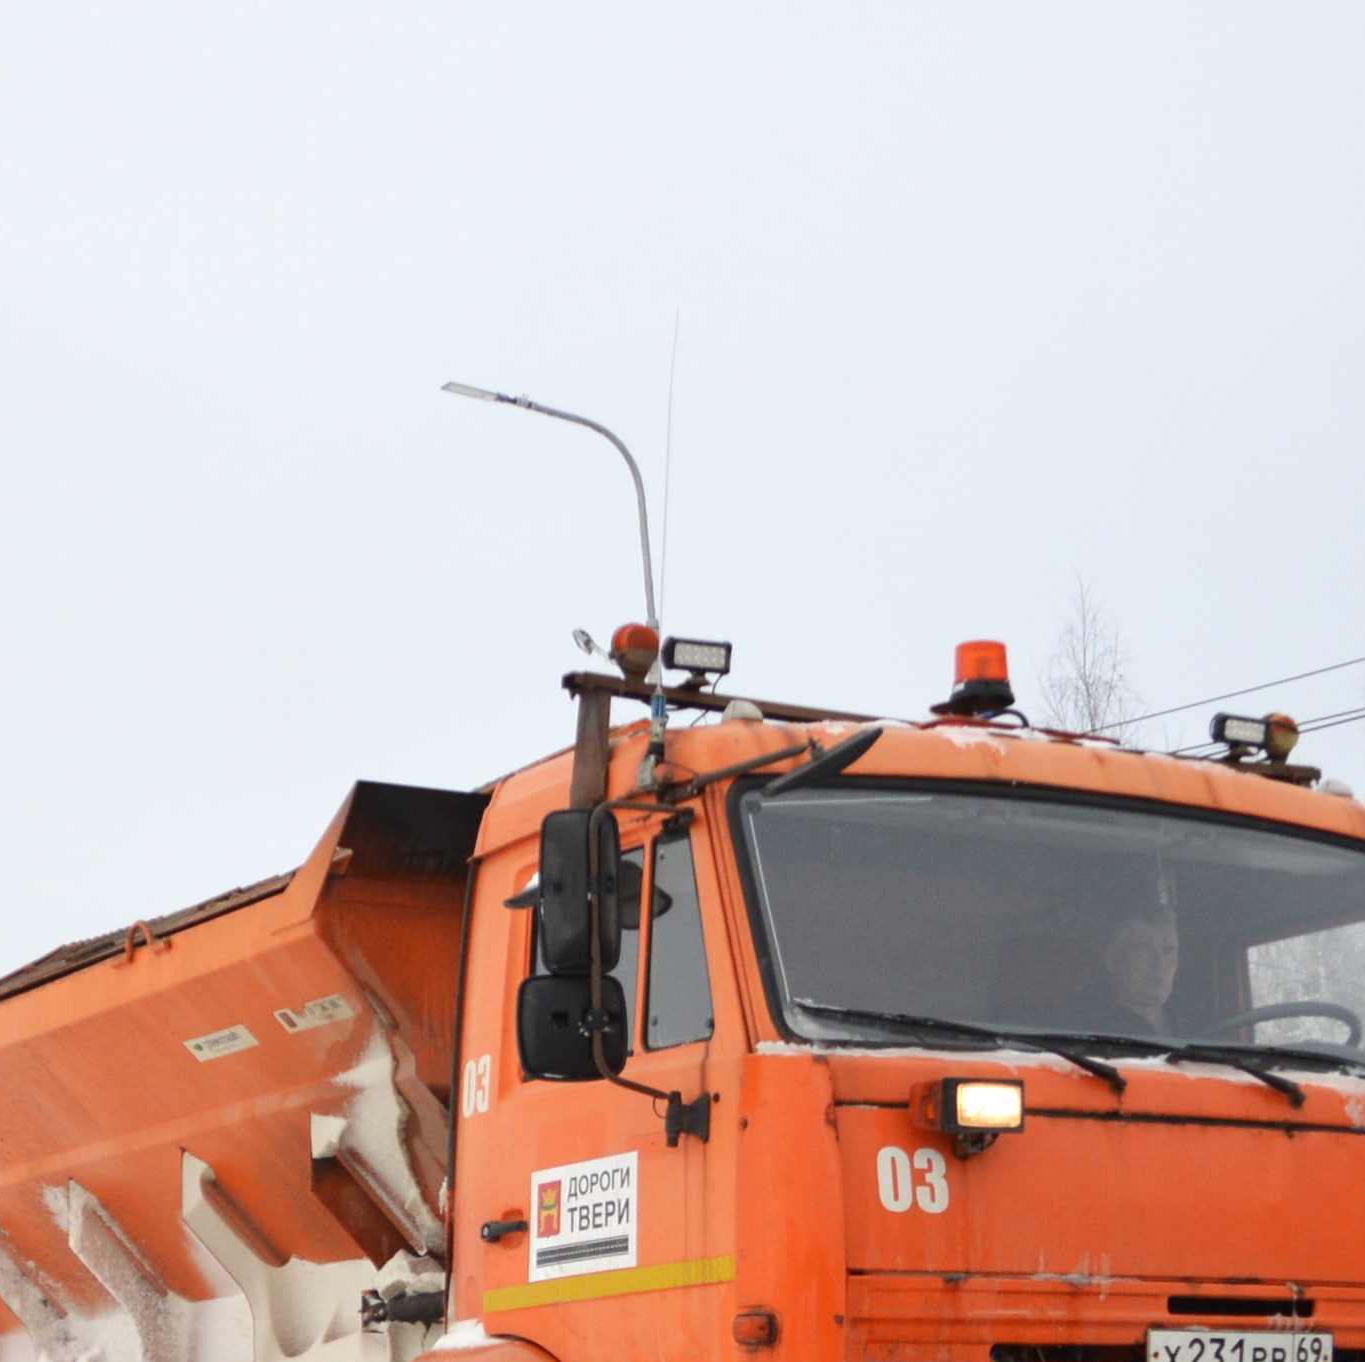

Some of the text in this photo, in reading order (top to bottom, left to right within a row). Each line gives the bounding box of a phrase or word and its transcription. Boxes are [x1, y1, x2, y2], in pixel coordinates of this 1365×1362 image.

[462, 1054, 492, 1118] 03
[567, 1166, 631, 1202] ДОРОГИ
[876, 1145, 950, 1214] 03
[567, 1197, 630, 1233] ТВЕРИ
